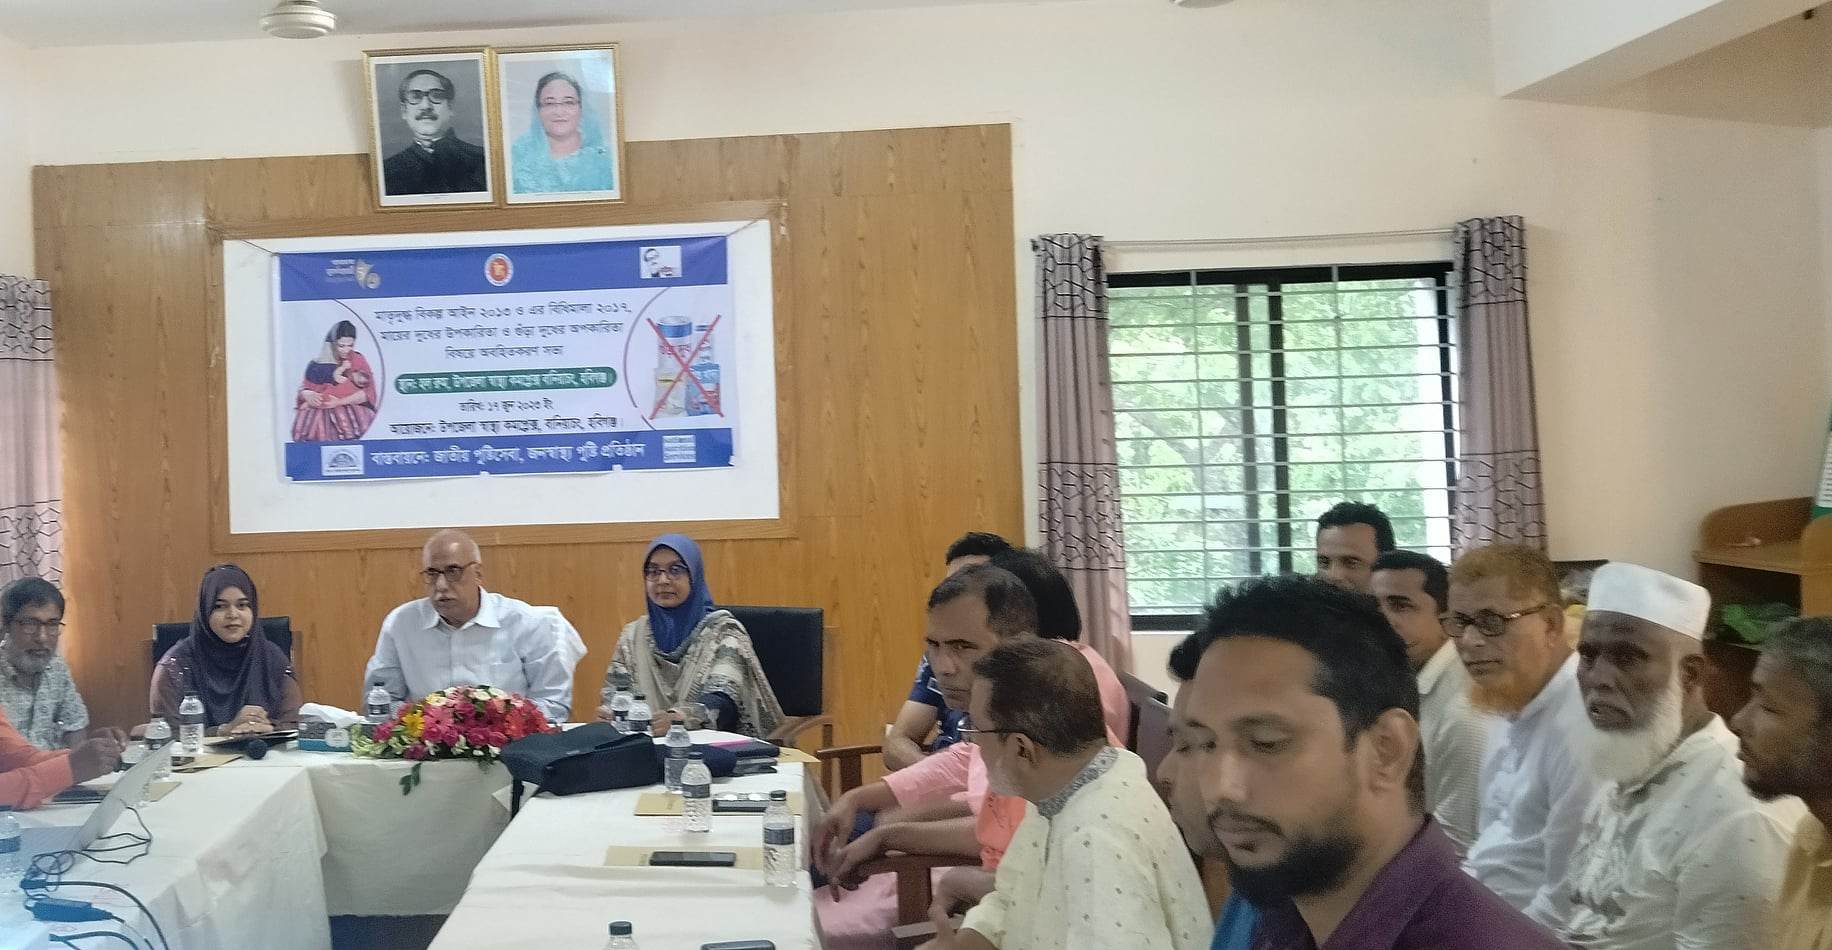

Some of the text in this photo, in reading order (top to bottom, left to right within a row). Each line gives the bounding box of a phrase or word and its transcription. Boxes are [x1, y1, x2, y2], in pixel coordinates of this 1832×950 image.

[445, 306, 475, 319] আইন
[480, 307, 511, 318] ২০১৩
[515, 306, 523, 316] ও
[530, 305, 544, 315] এর
[503, 327, 510, 337] ও
[542, 345, 564, 356] সভা
[517, 400, 540, 411] ২০২৩
[438, 419, 477, 433] উপজেলা
